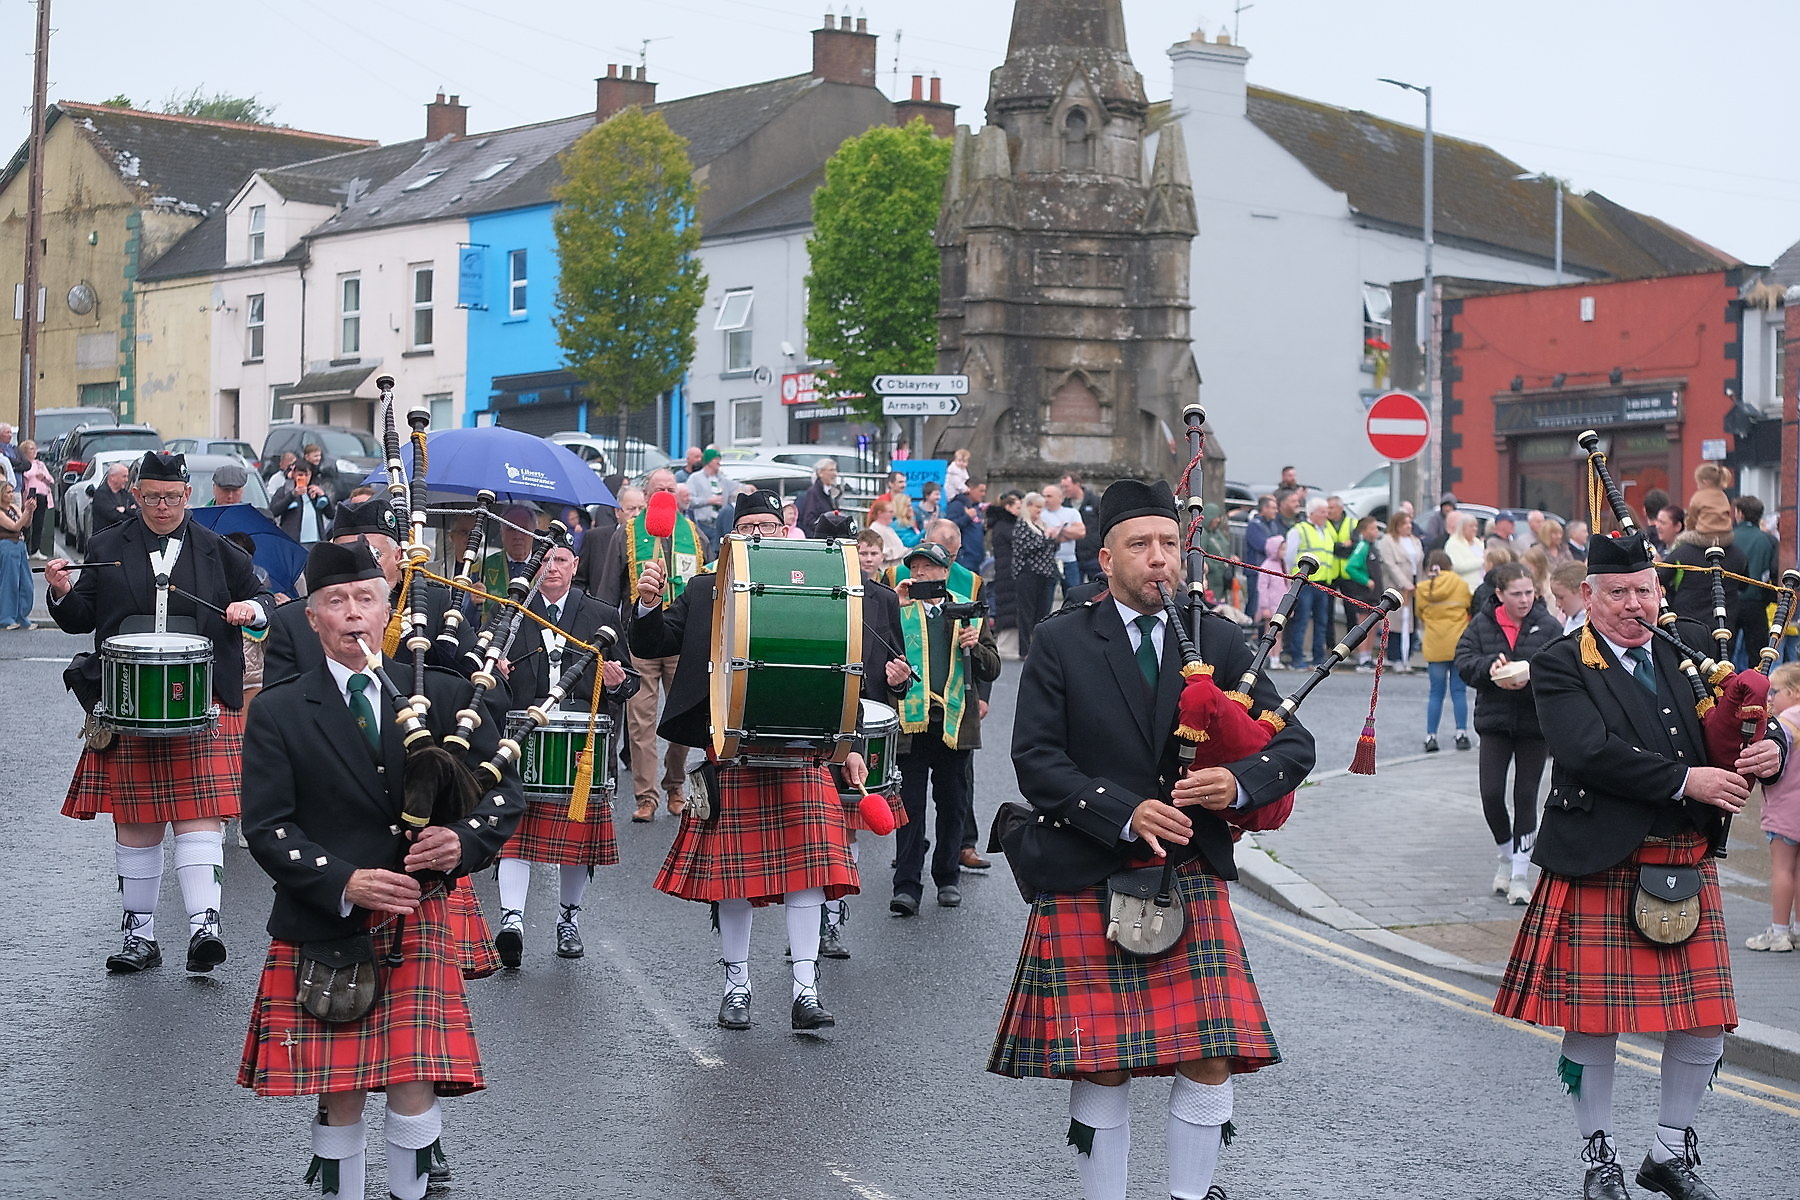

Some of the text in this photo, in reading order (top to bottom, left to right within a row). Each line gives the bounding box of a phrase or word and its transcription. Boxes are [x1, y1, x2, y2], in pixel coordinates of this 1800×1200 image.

[887, 380, 964, 391] C'blayney 10
[888, 401, 946, 411] Armagh 8
[1538, 415, 1614, 427] PROPERTY SALES
[520, 468, 545, 478] Liberty
[120, 664, 129, 716] Premier
[523, 732, 535, 783] Premier
